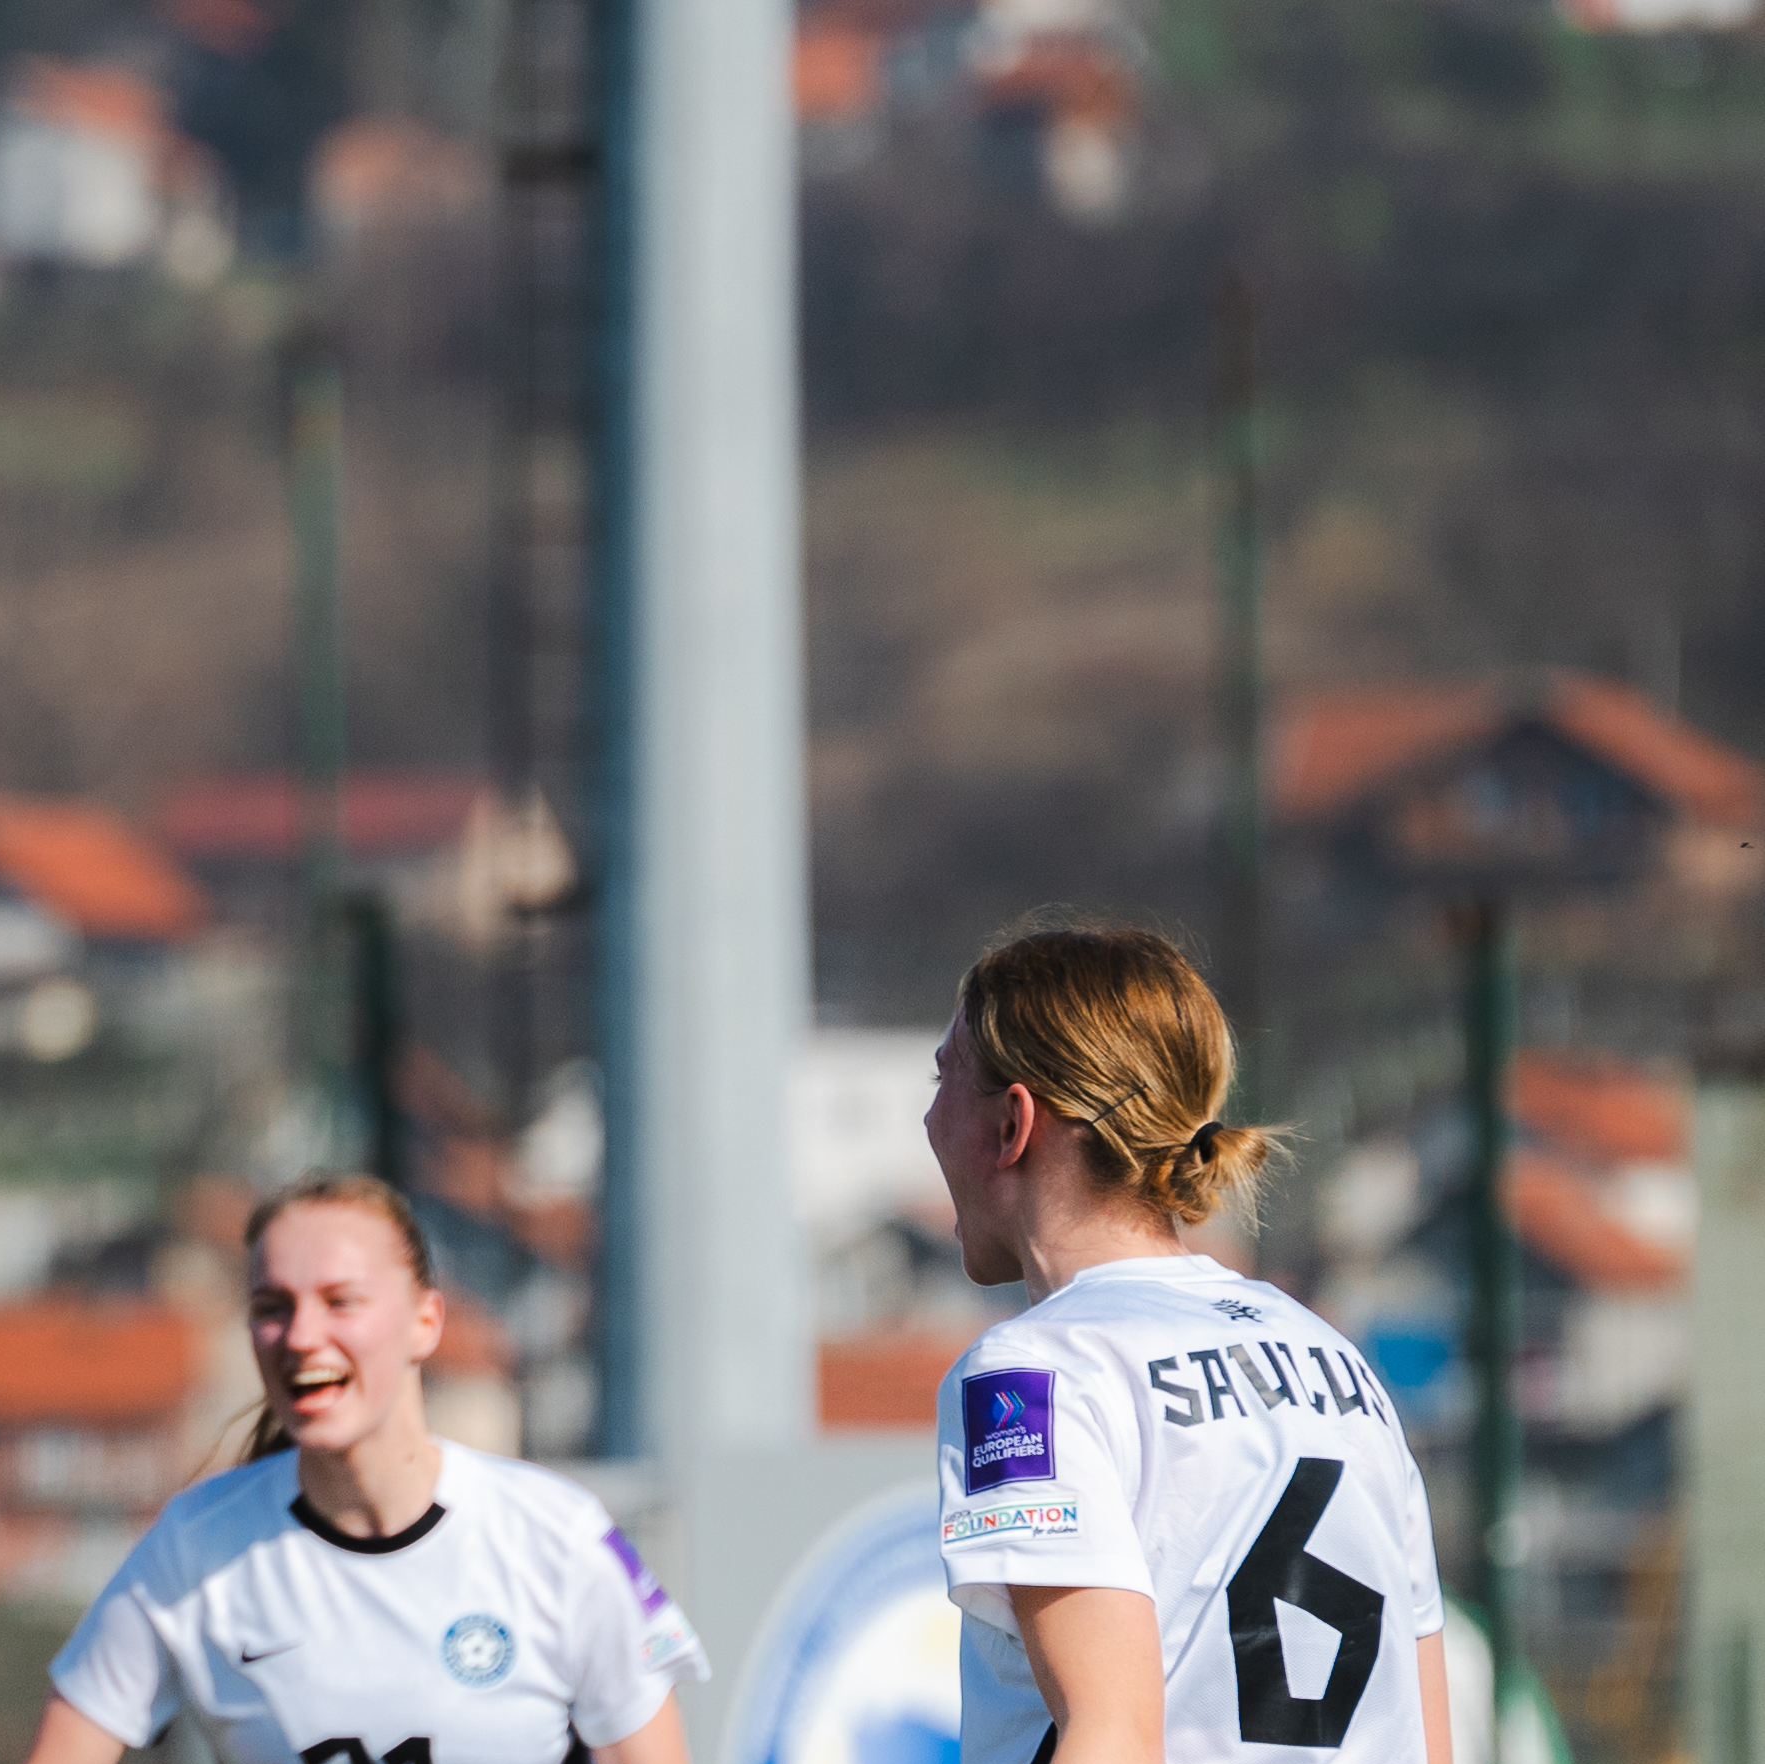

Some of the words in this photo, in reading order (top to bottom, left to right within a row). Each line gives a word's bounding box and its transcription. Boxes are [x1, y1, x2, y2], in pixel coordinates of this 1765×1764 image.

[972, 1443, 1045, 1468] QUALIFIERS
[973, 1432, 1043, 1457] EUROPEAN
[1226, 1456, 1385, 1748] 6
